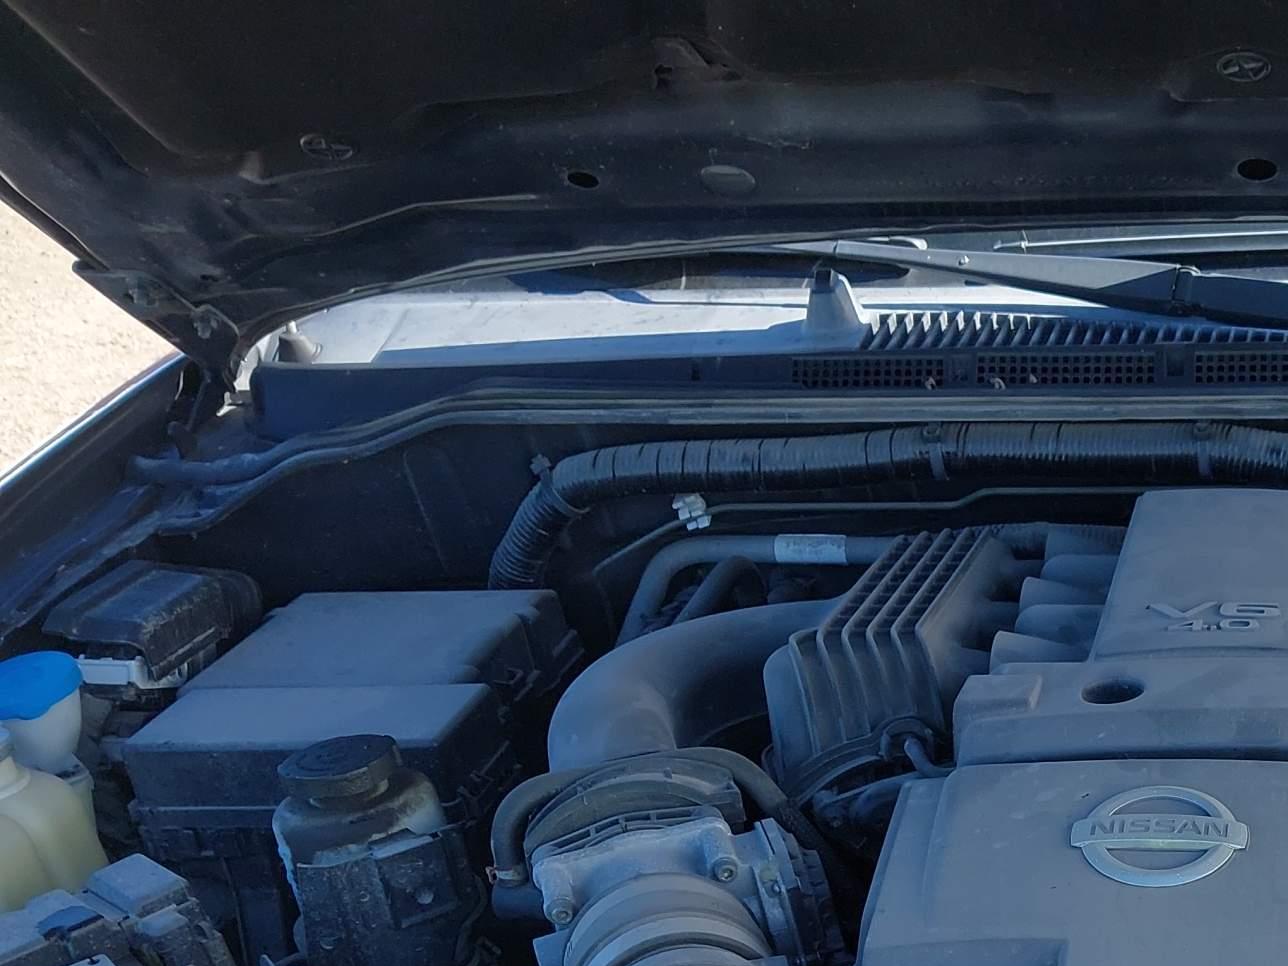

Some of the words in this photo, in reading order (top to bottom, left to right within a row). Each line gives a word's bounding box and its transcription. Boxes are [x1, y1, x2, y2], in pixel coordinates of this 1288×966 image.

[1145, 601, 1282, 618] V6
[1165, 618, 1260, 632] 4.0
[1089, 817, 1230, 838] NISSAN
